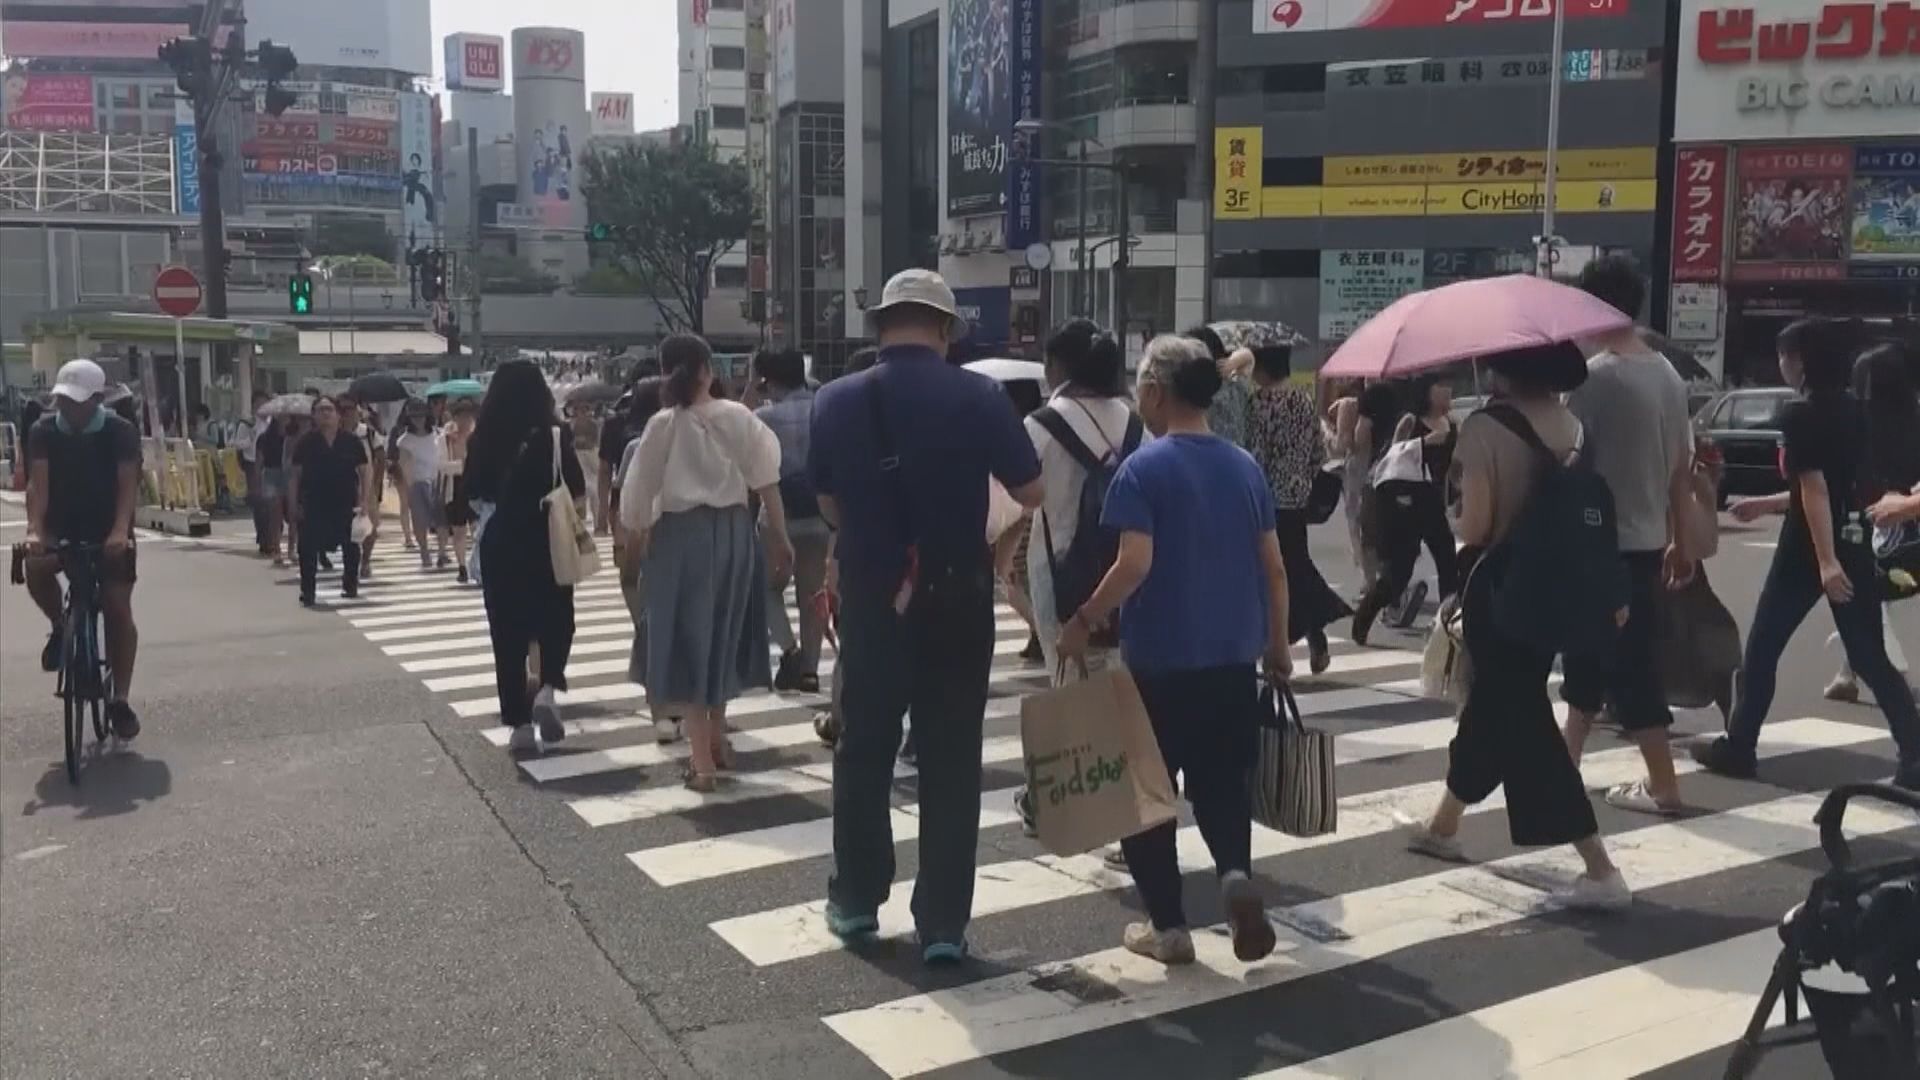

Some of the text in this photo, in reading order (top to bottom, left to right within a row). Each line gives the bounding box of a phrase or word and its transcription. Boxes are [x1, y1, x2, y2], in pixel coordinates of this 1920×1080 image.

[1224, 188, 1250, 208] 3F
[1685, 159, 1716, 262] カラオケ
